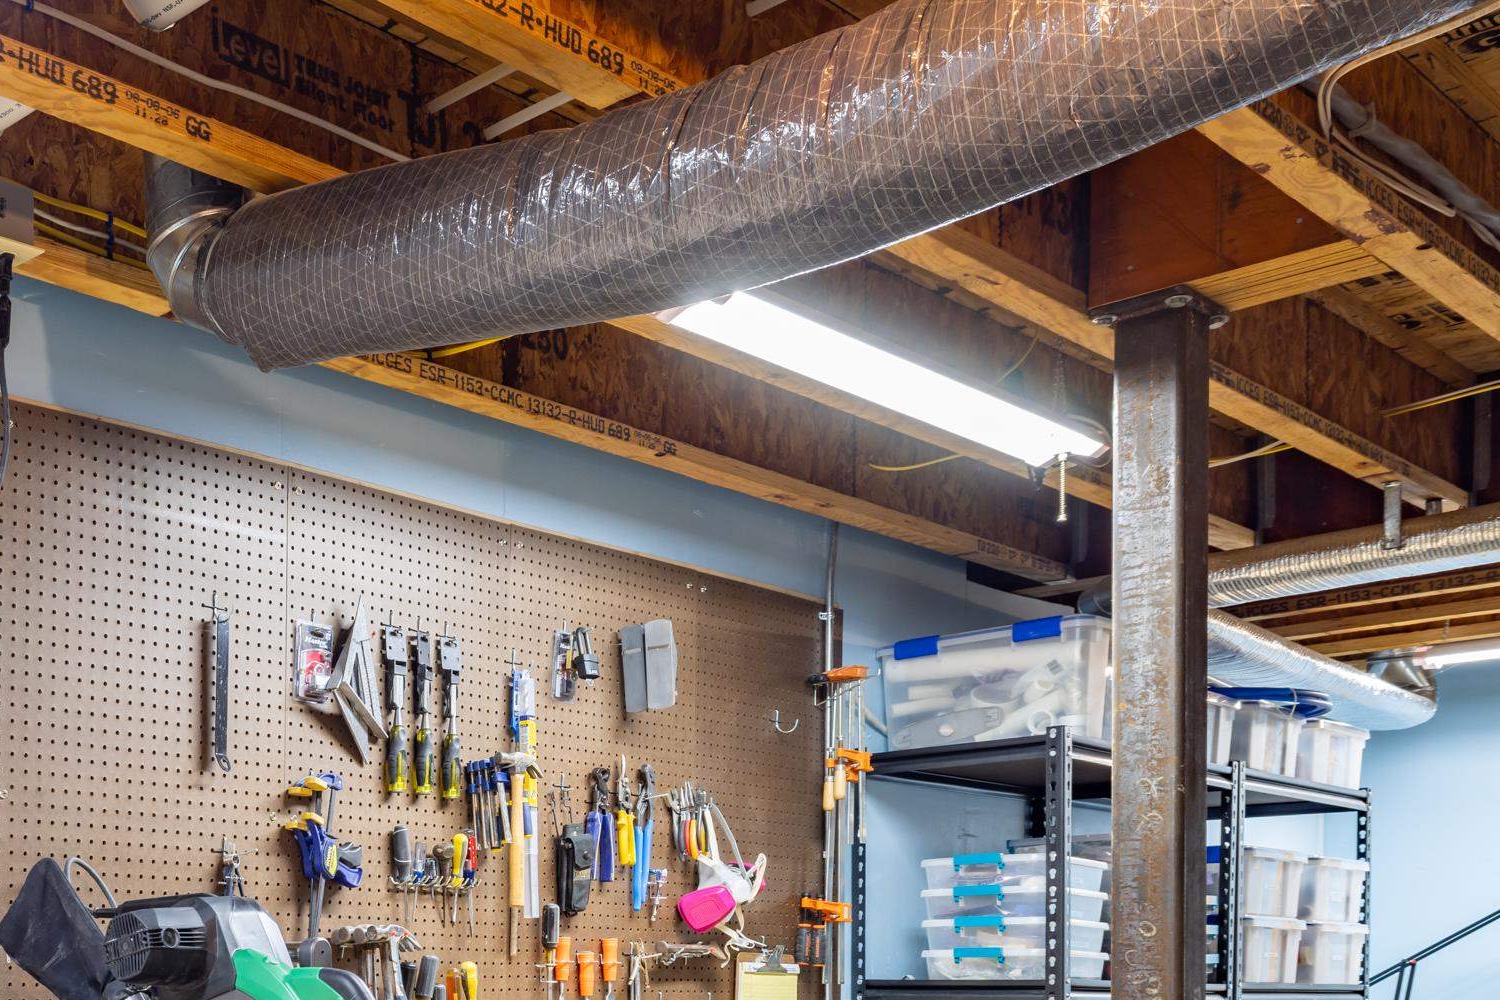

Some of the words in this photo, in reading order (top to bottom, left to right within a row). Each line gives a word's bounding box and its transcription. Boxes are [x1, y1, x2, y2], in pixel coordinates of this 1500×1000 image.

[587, 39, 625, 76] 689
[71, 70, 119, 105] 689
[185, 115, 212, 142] GG
